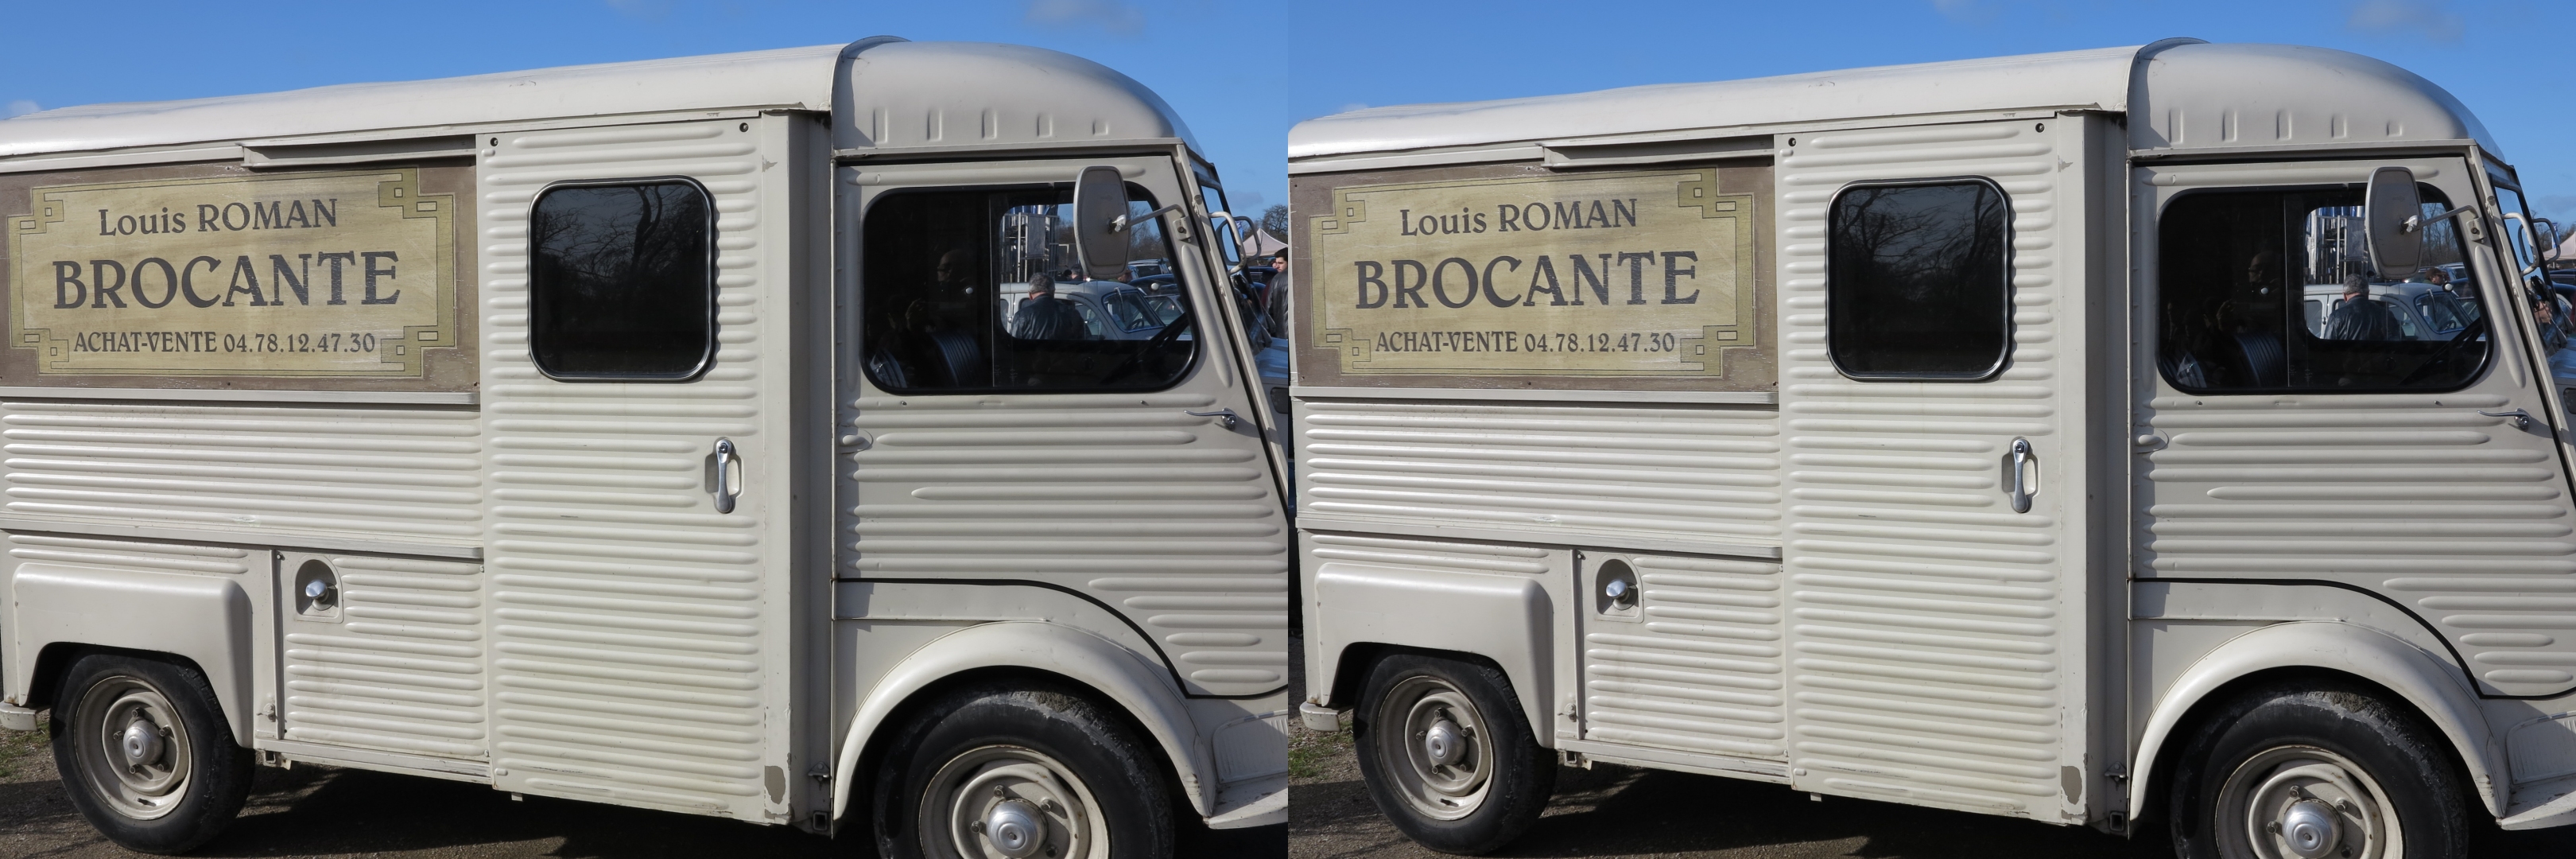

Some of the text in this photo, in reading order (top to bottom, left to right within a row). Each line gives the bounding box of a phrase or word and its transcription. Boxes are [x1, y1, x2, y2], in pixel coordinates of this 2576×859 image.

[99, 199, 338, 236] Louis ROMAN
[1400, 199, 1638, 236] Louis ROMAN
[52, 251, 401, 309] BROCANTE
[1355, 251, 1701, 309] BROCANTE
[74, 331, 375, 353] ACHAT-VENTE 04.78.12.47.30
[1375, 331, 1675, 353] ACHAT-VENTE 04.78.12.47.30
